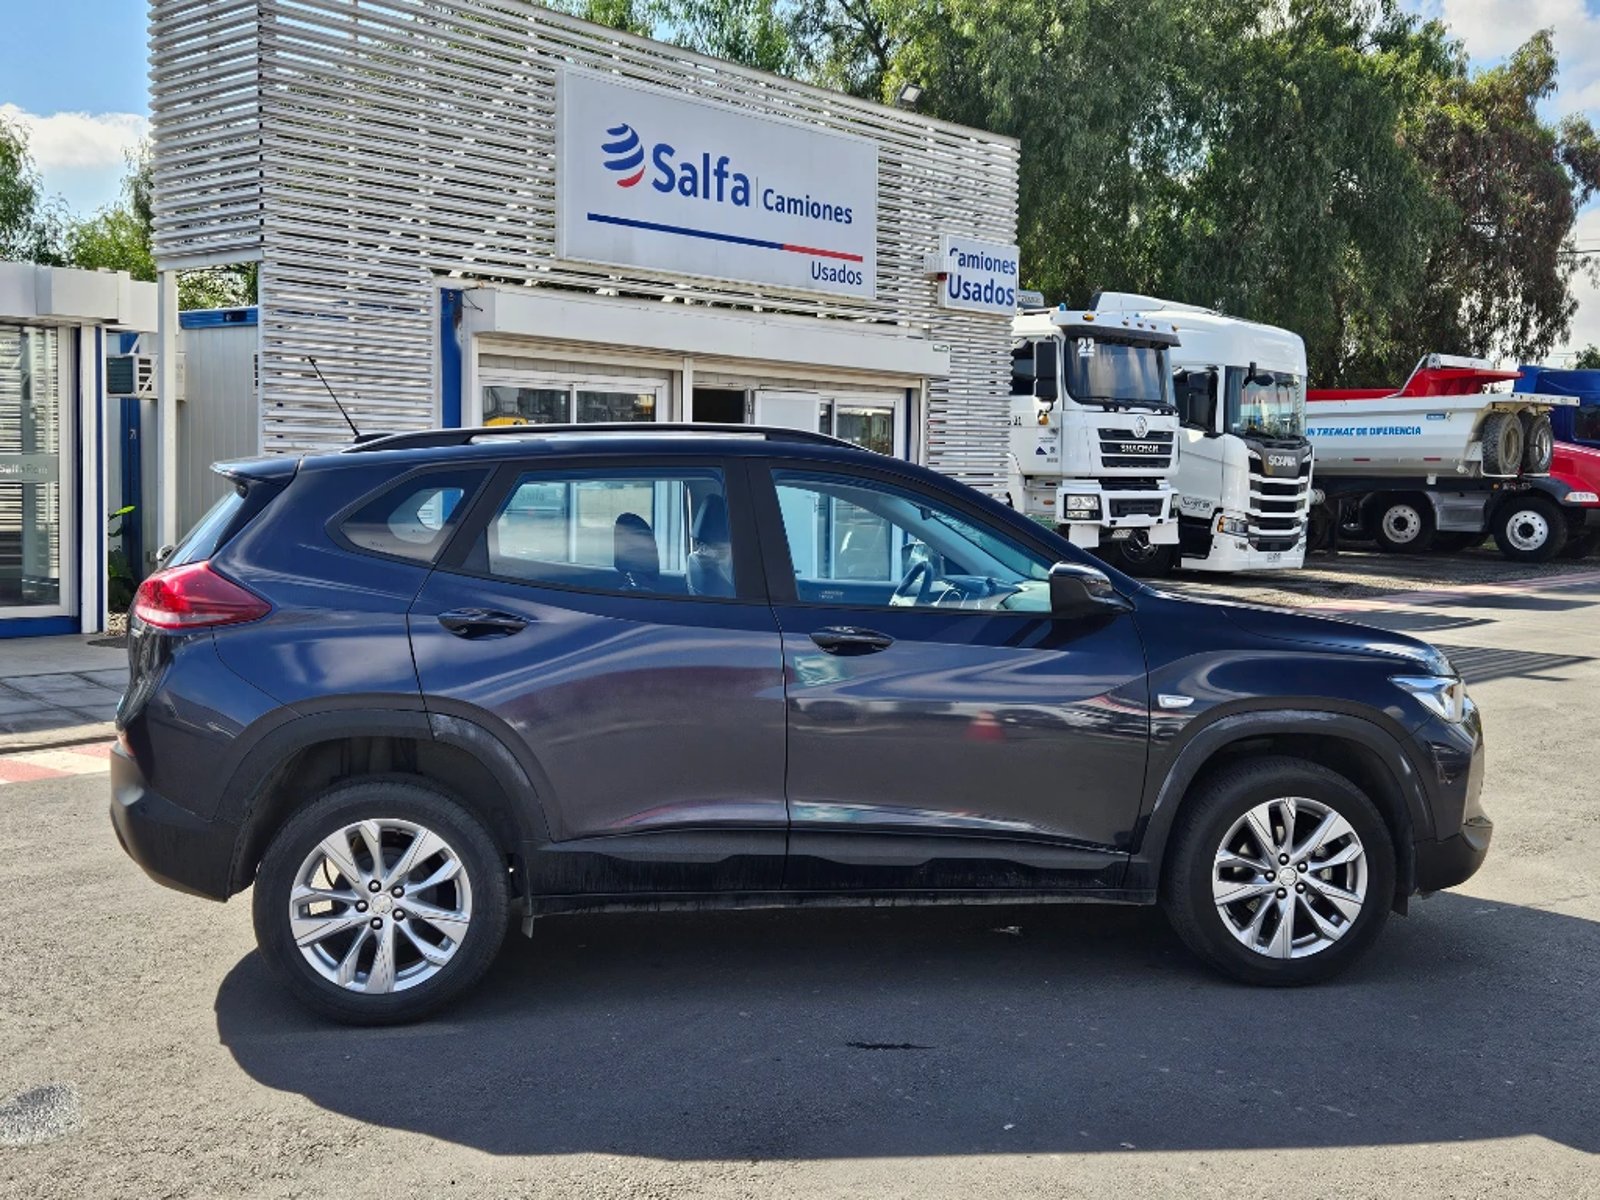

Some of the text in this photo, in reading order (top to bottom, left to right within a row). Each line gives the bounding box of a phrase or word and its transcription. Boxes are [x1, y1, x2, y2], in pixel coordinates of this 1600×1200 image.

[652, 143, 853, 224] Salfa Camiones
[811, 260, 863, 285] Usados
[949, 273, 1015, 306] Usados
[1369, 426, 1421, 435] DIFERENCIA
